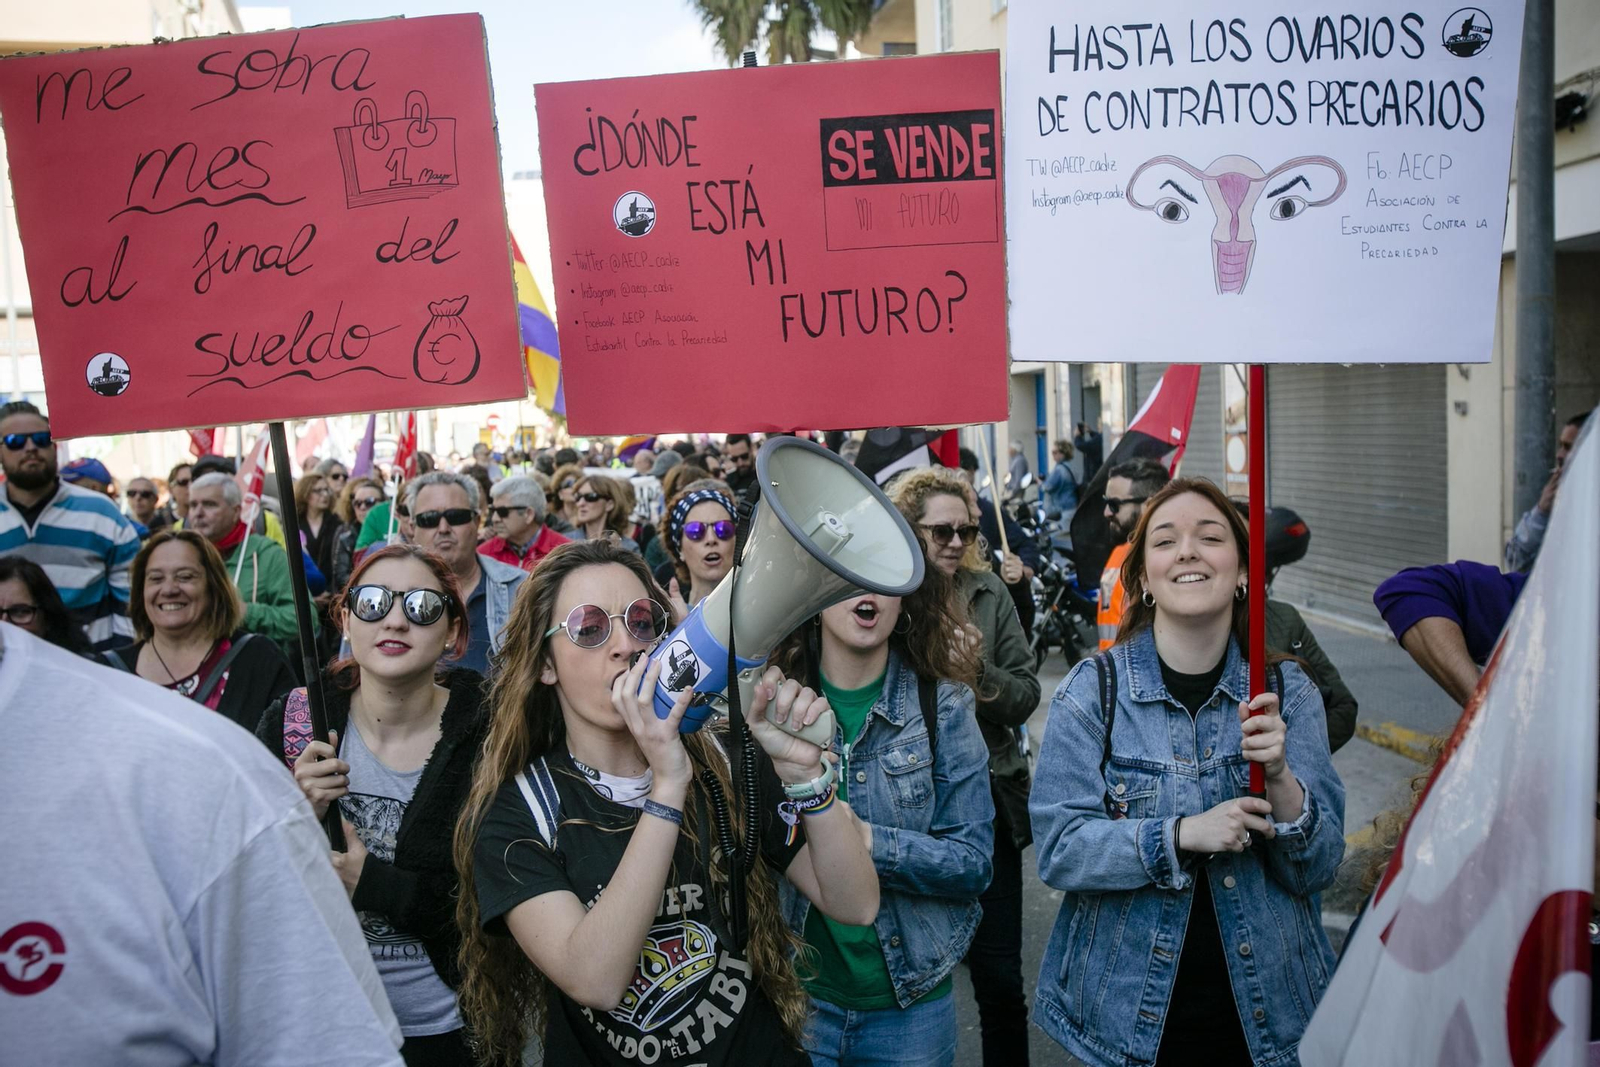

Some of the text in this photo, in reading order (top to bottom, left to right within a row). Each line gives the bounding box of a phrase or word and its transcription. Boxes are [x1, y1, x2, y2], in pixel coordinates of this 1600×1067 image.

[1049, 11, 1426, 73] HASTA LOS OVARIOS
[36, 66, 145, 123] me
[1038, 76, 1486, 136] DE CONTRATOS PRECARIOS
[385, 147, 413, 187] 1
[573, 107, 702, 177] ¿DÓNDE
[828, 123, 992, 180] SE VENDE
[1398, 152, 1453, 180] AECP
[126, 140, 275, 205] mes
[686, 164, 765, 234] ESTÁ
[1032, 187, 1072, 217] Instagram
[60, 216, 461, 307] al final del
[745, 239, 787, 286] MI
[581, 282, 617, 306] Instagram
[780, 269, 967, 343] FUTURO?
[187, 301, 401, 377] sueldo
[662, 1038, 679, 1050] POR
[670, 1046, 687, 1059] EL
